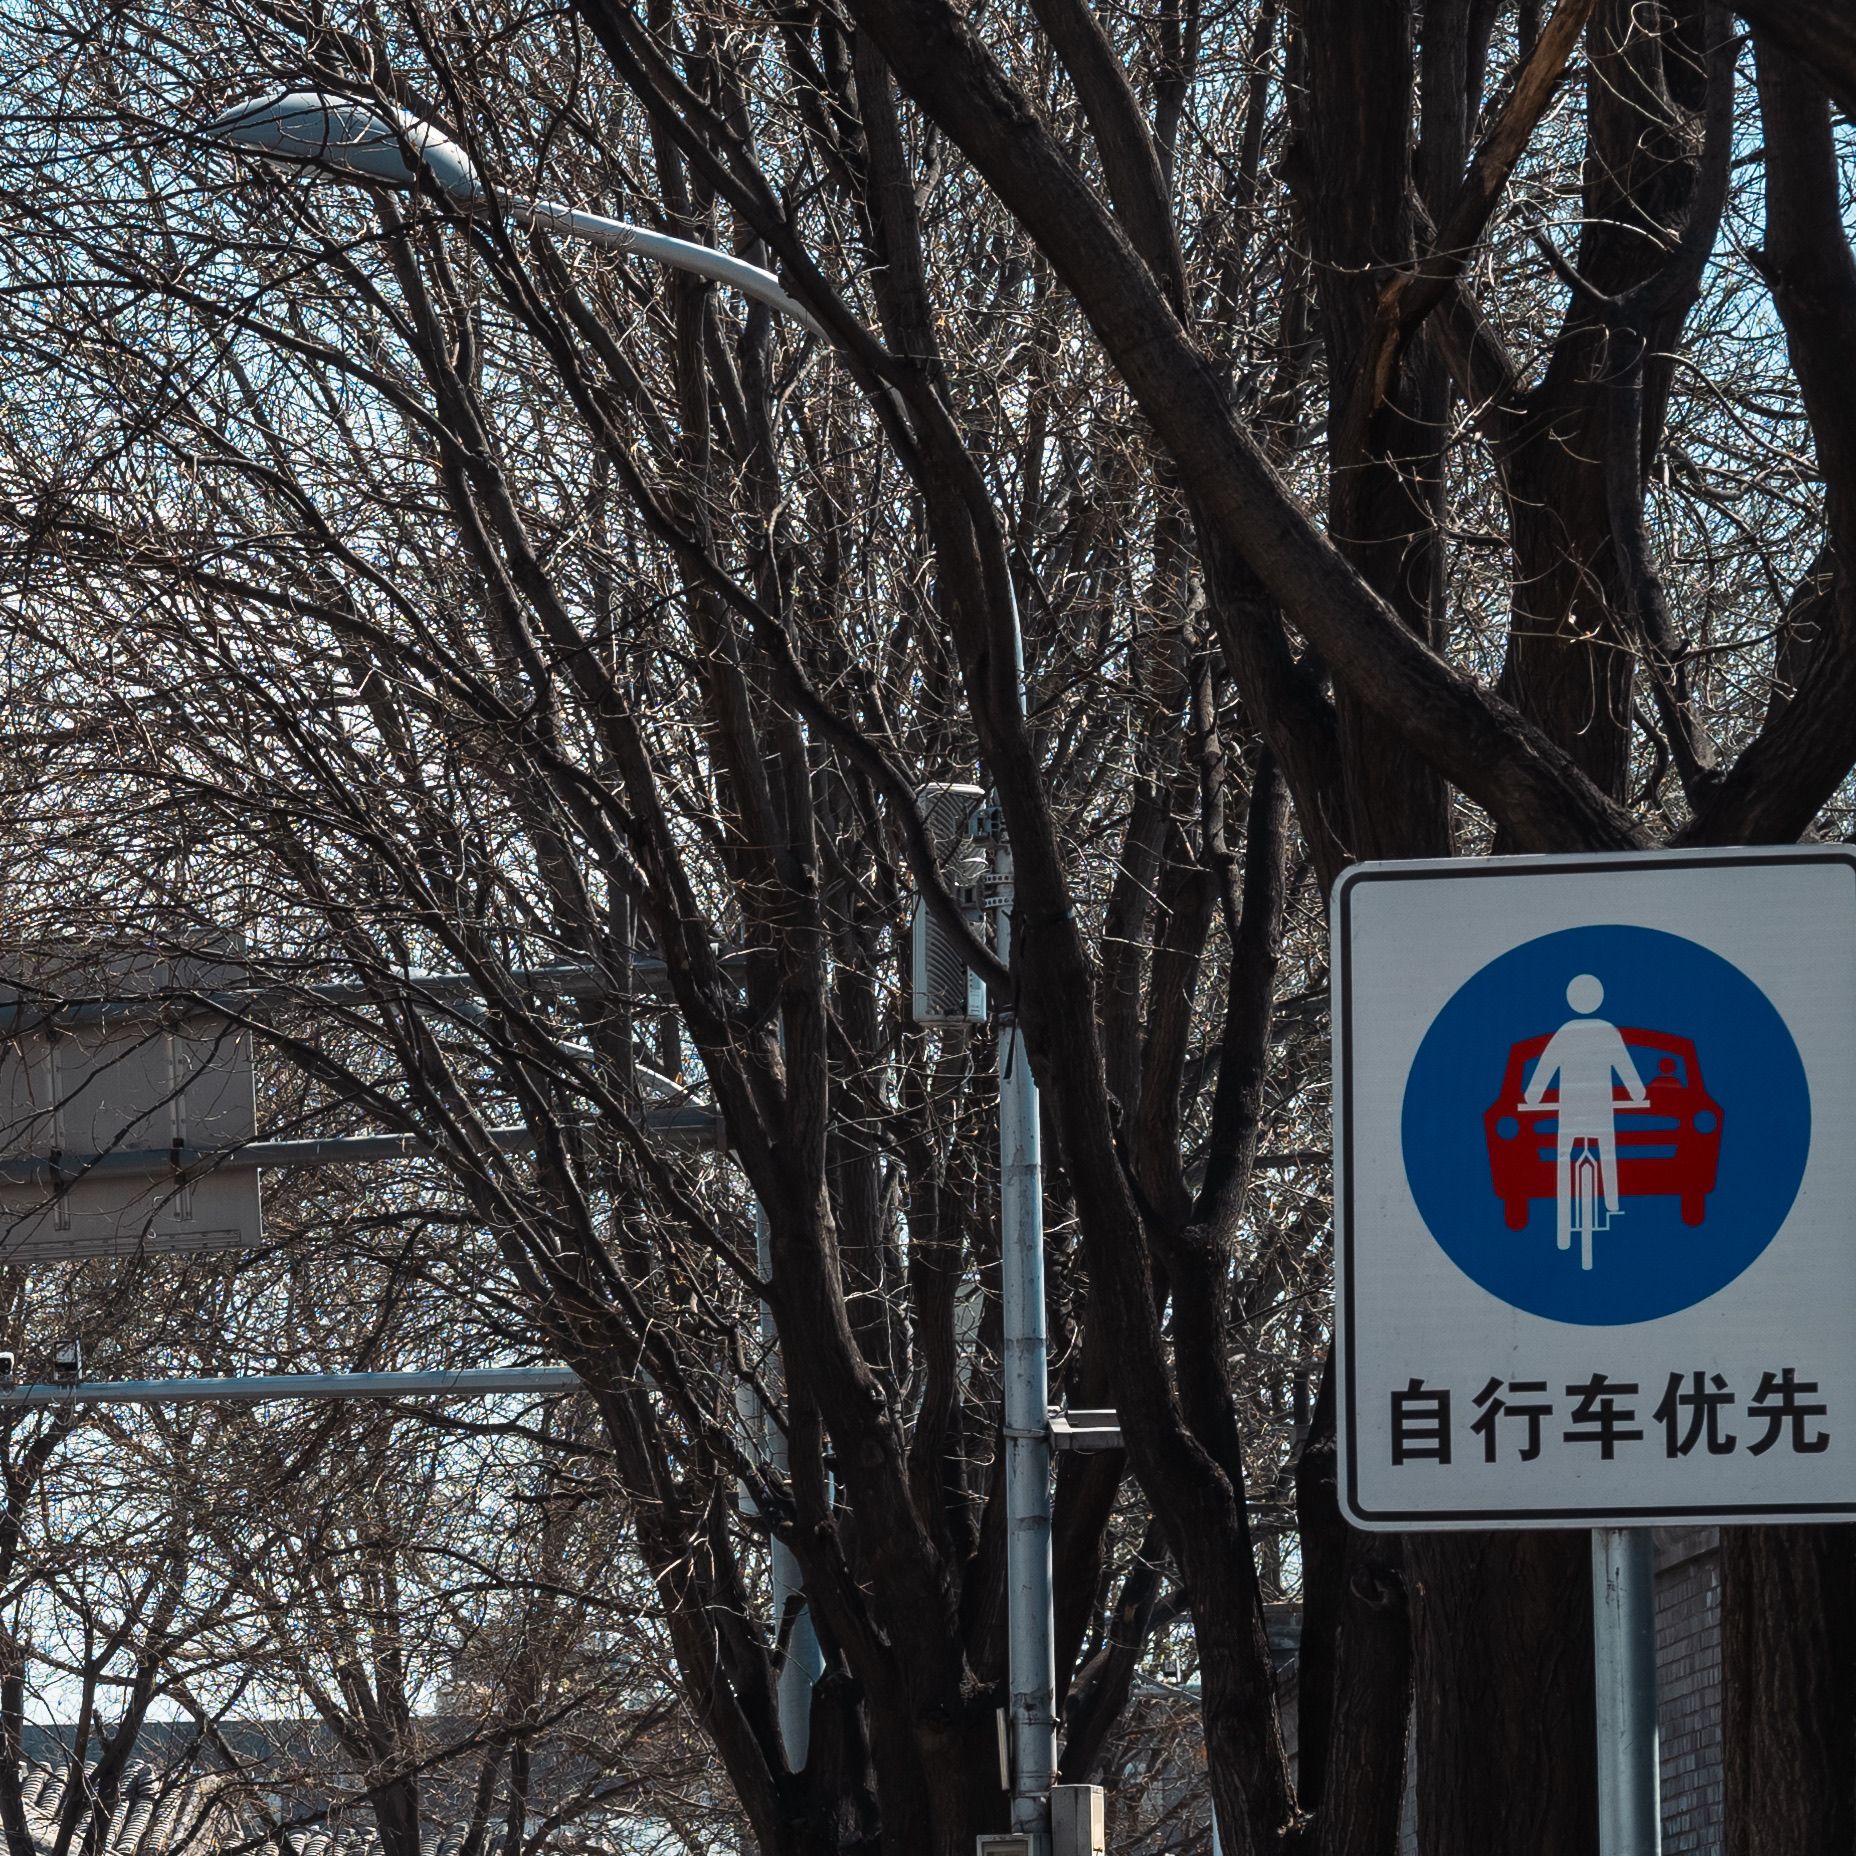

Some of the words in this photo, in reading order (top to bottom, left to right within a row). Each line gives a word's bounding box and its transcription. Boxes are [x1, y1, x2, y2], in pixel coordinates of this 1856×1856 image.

[1391, 1367, 1830, 1466] 自行车优先
